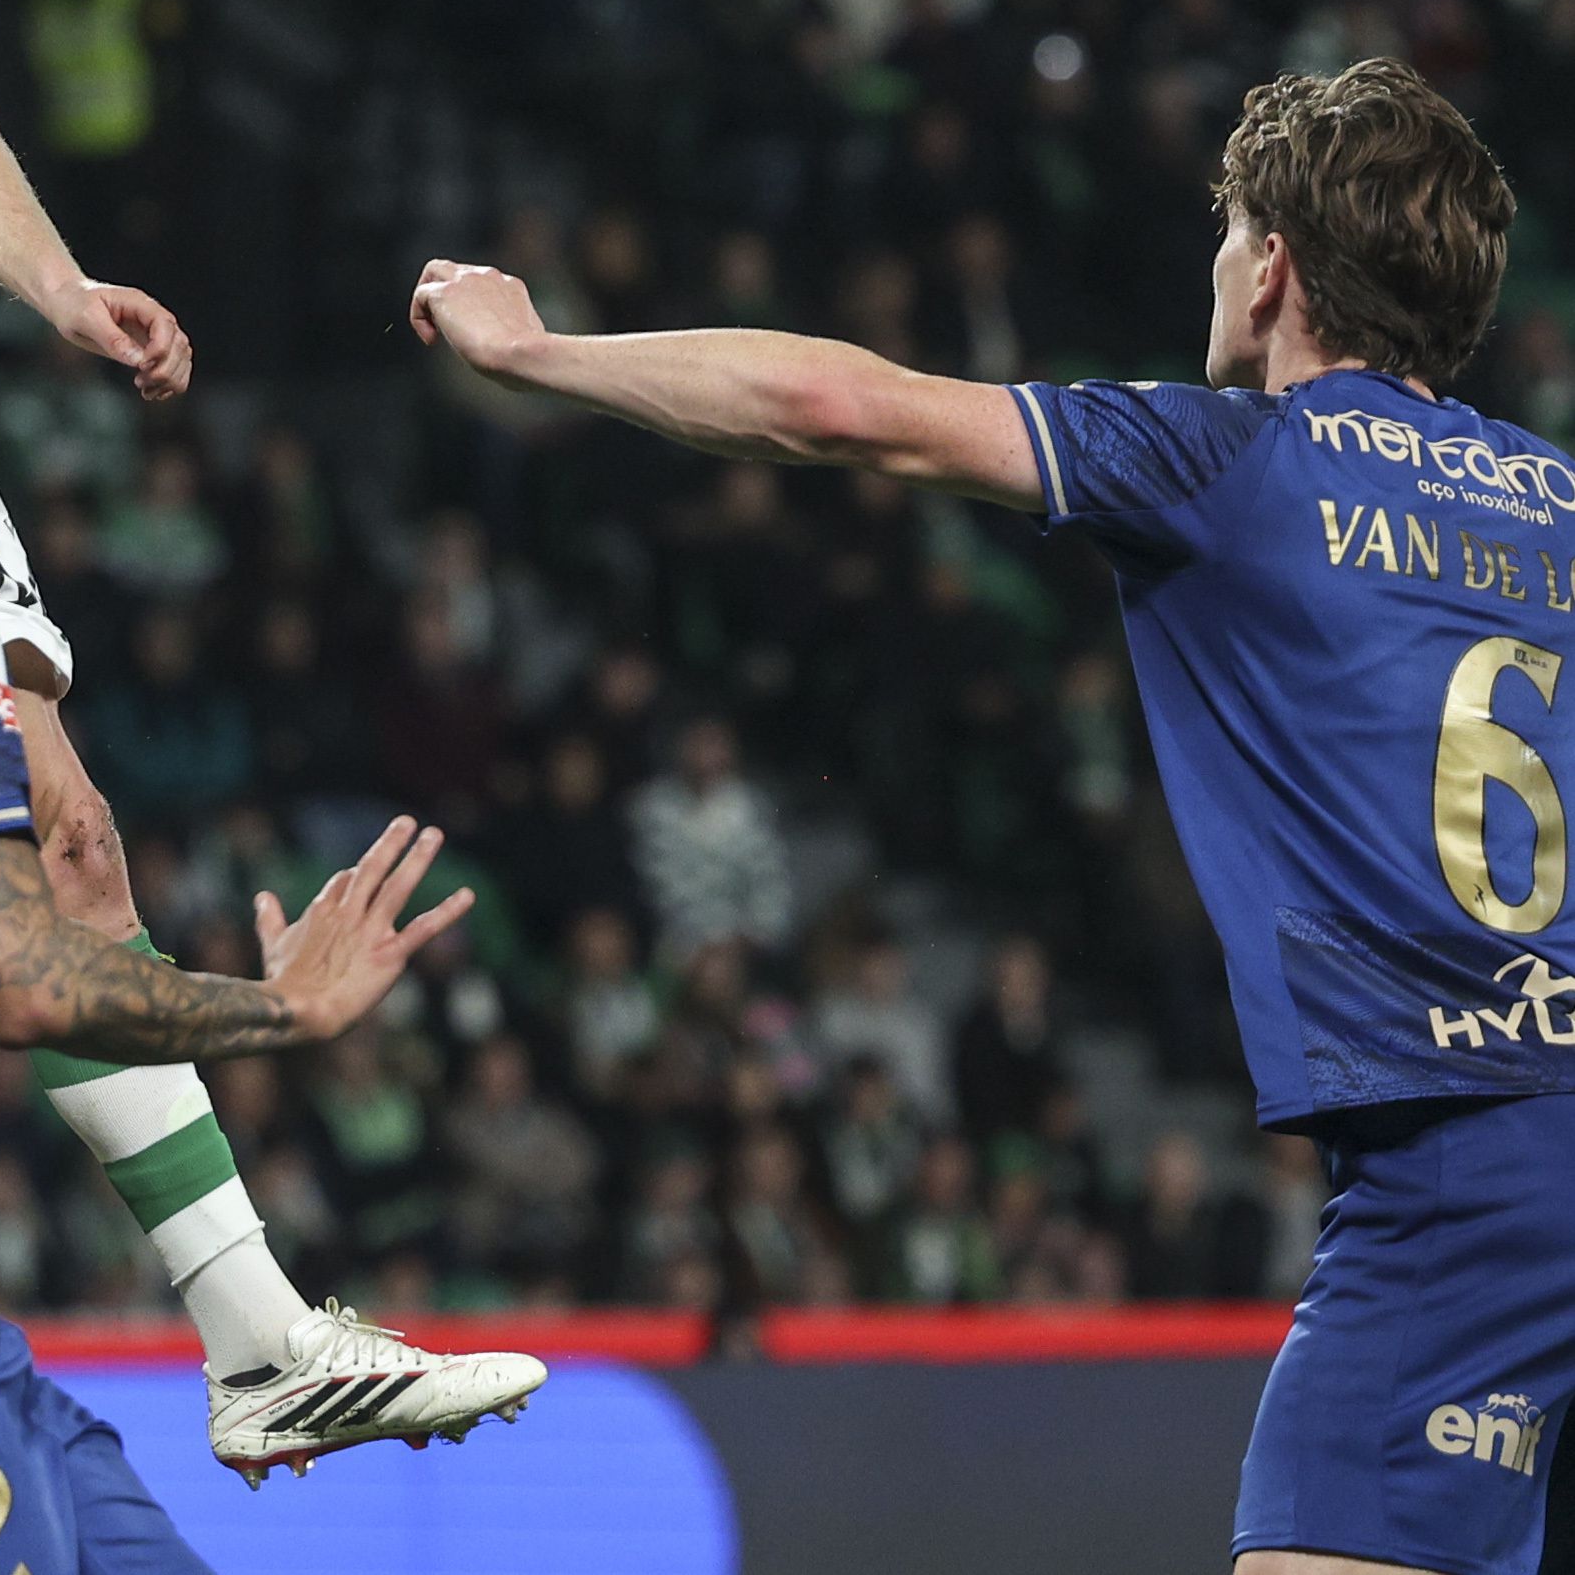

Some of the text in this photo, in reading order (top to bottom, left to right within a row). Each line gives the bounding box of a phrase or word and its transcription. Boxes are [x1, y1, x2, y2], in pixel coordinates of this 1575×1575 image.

[1319, 499, 1575, 613] VAN DE L
[1417, 479, 1554, 525] aço inoxidável
[1433, 636, 1569, 936] 6
